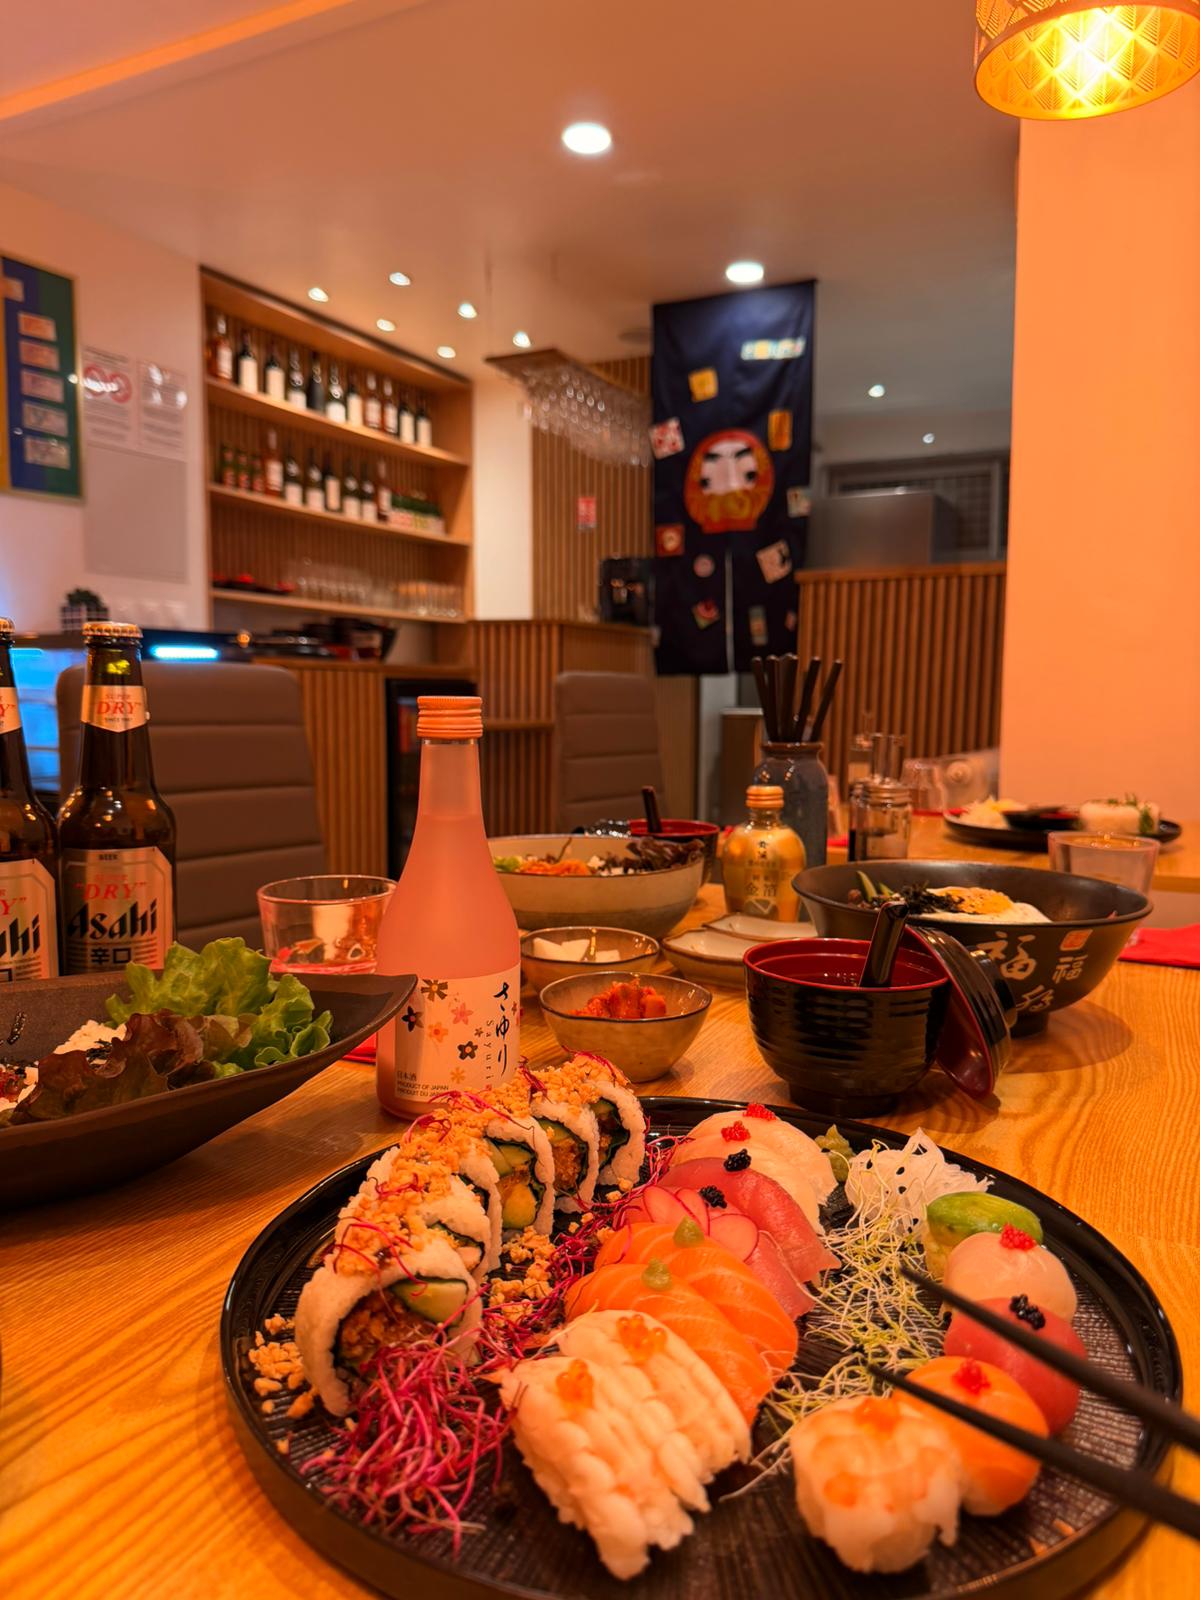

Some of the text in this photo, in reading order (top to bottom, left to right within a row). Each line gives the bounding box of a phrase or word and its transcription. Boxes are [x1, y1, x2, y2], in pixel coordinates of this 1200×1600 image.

[67, 898, 157, 940] Asahi
[90, 945, 131, 965] 辛口
[484, 1020, 493, 1080] Sayuri
[397, 1080, 421, 1090] PRODUCT
